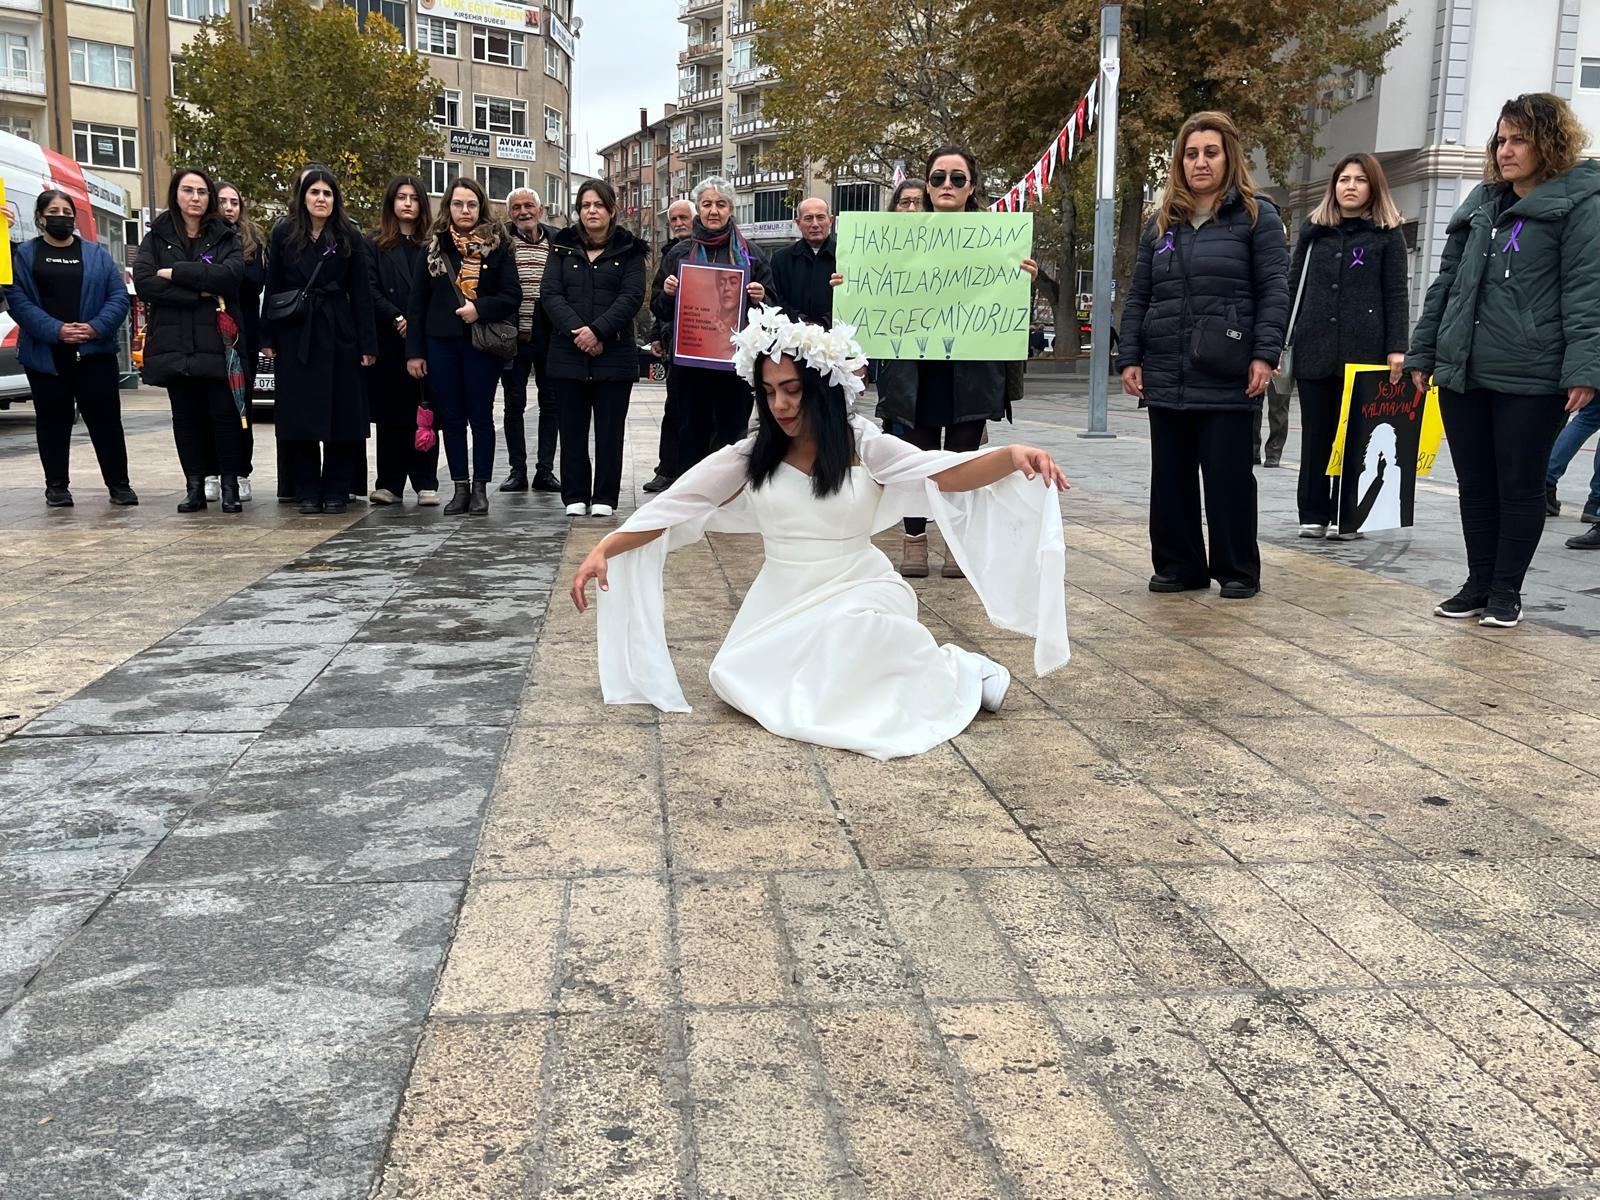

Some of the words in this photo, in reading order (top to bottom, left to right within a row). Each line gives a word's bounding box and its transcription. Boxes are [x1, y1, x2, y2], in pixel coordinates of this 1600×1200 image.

[452, 135, 489, 147] AVUKAT
[499, 138, 533, 148] AVUKAT
[850, 222, 1029, 254] HAKLARIMIZDAN
[846, 262, 1021, 296] HAYATLARIMIZDAN
